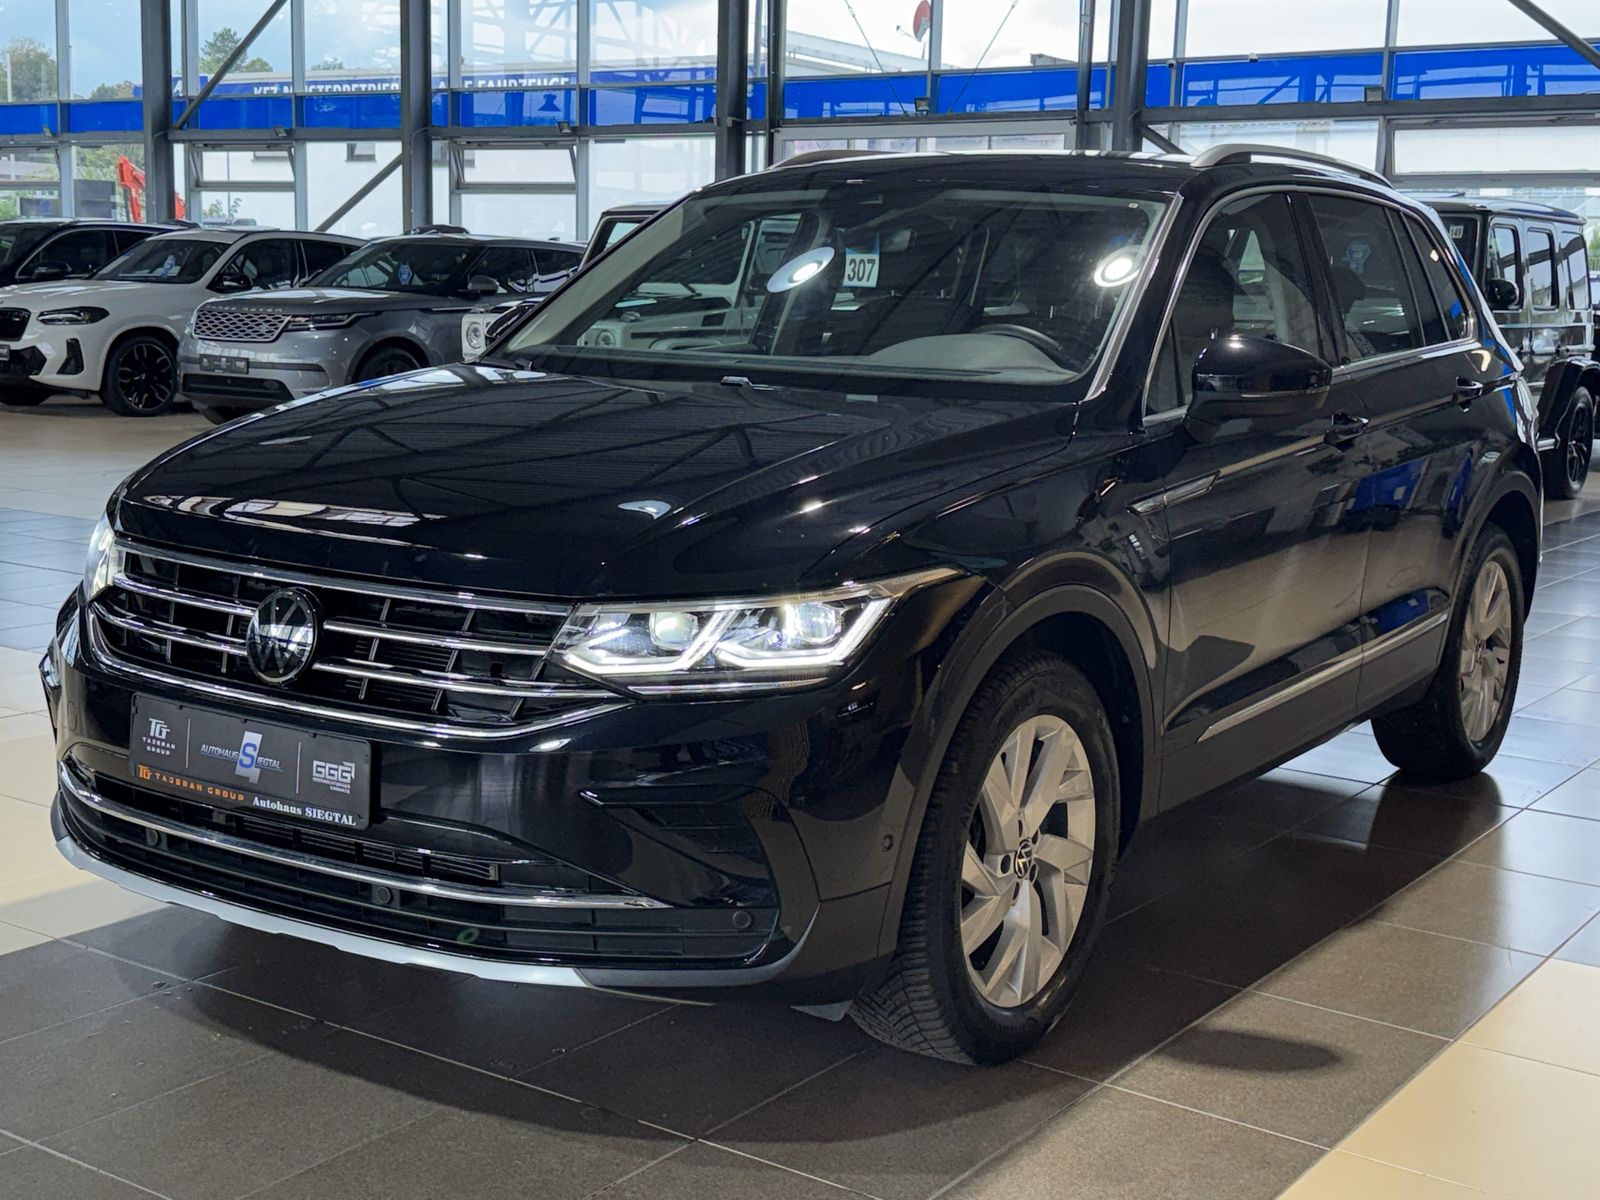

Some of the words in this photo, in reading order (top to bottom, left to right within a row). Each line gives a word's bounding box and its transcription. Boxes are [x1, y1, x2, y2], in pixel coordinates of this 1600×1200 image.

[847, 258, 876, 282] 307
[200, 744, 239, 760] AUTOHAUS
[313, 760, 352, 783] GGG
[207, 786, 245, 801] GROUP
[252, 796, 302, 815] Autohaus
[305, 806, 357, 826] SIEGTAL
